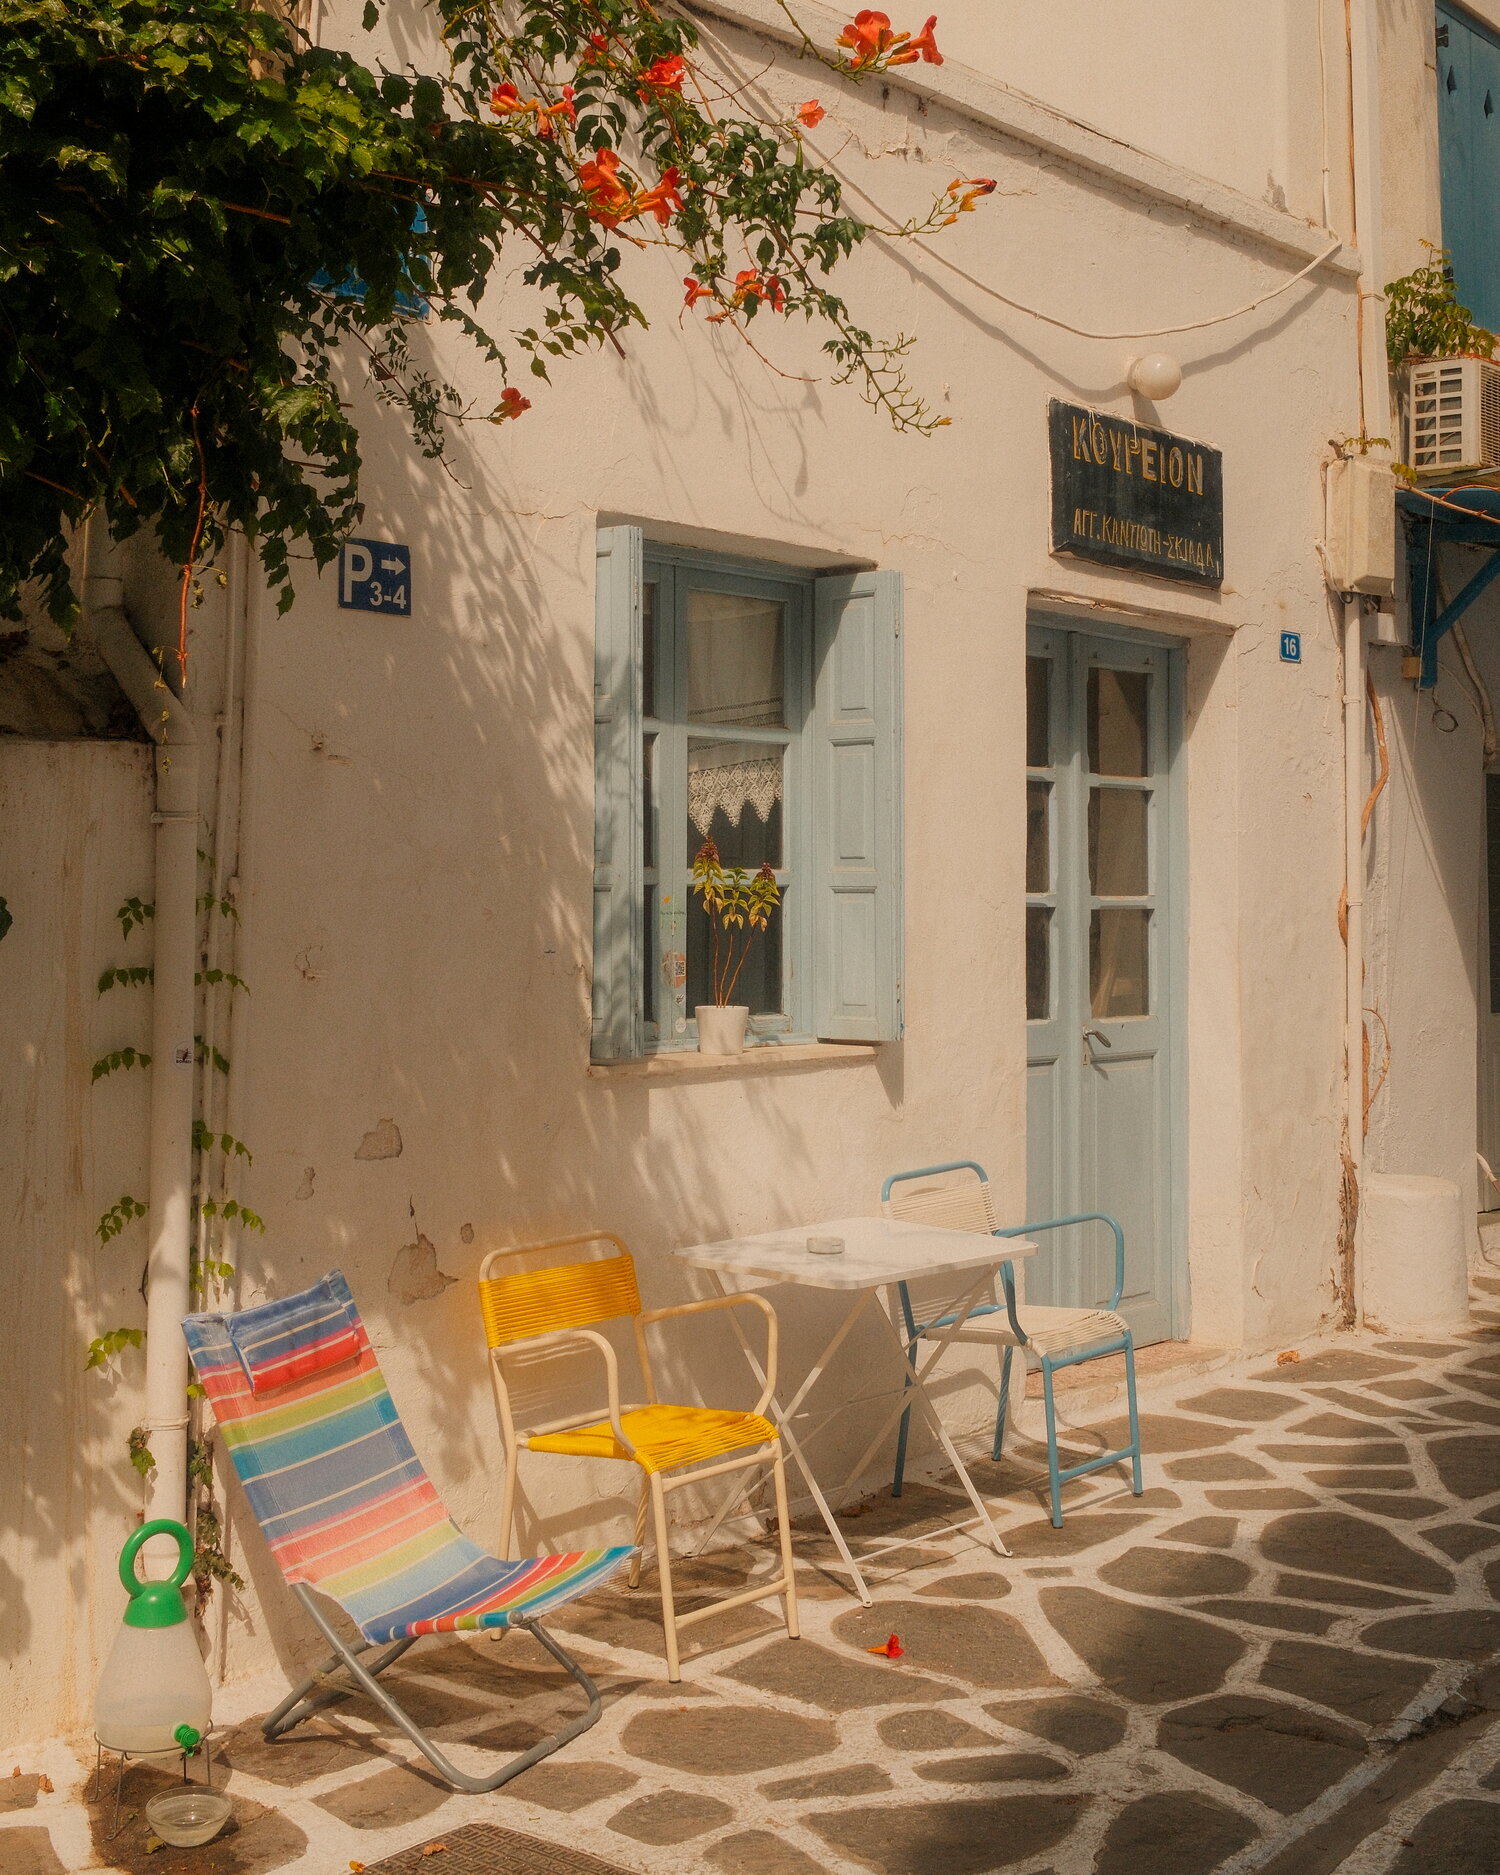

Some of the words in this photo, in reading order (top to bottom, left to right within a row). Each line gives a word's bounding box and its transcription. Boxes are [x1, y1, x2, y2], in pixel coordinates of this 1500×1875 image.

[1072, 415, 1204, 496] ΚΟΥΡΕΙΟΝ
[343, 543, 373, 603] P
[369, 581, 407, 610] 3-4
[1284, 637, 1297, 656] 16
